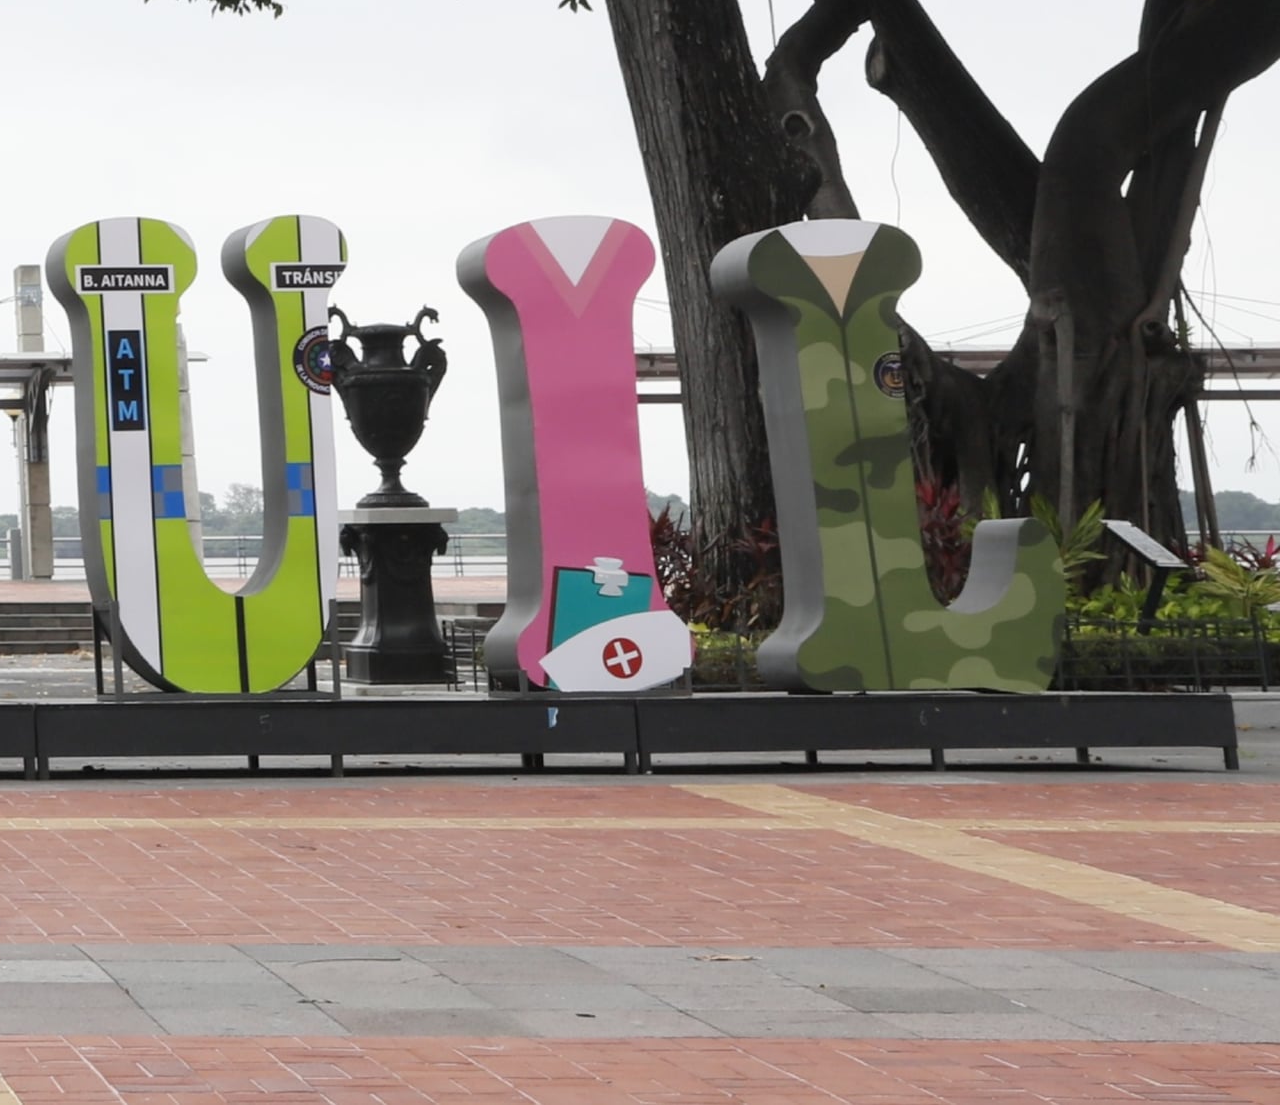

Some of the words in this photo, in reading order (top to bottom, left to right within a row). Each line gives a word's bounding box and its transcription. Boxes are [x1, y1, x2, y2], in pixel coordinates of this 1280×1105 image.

[83, 274, 99, 288] B.
[101, 273, 166, 287] AITANNA
[282, 267, 343, 285] TRÁNSI
[116, 338, 139, 421] ATM
